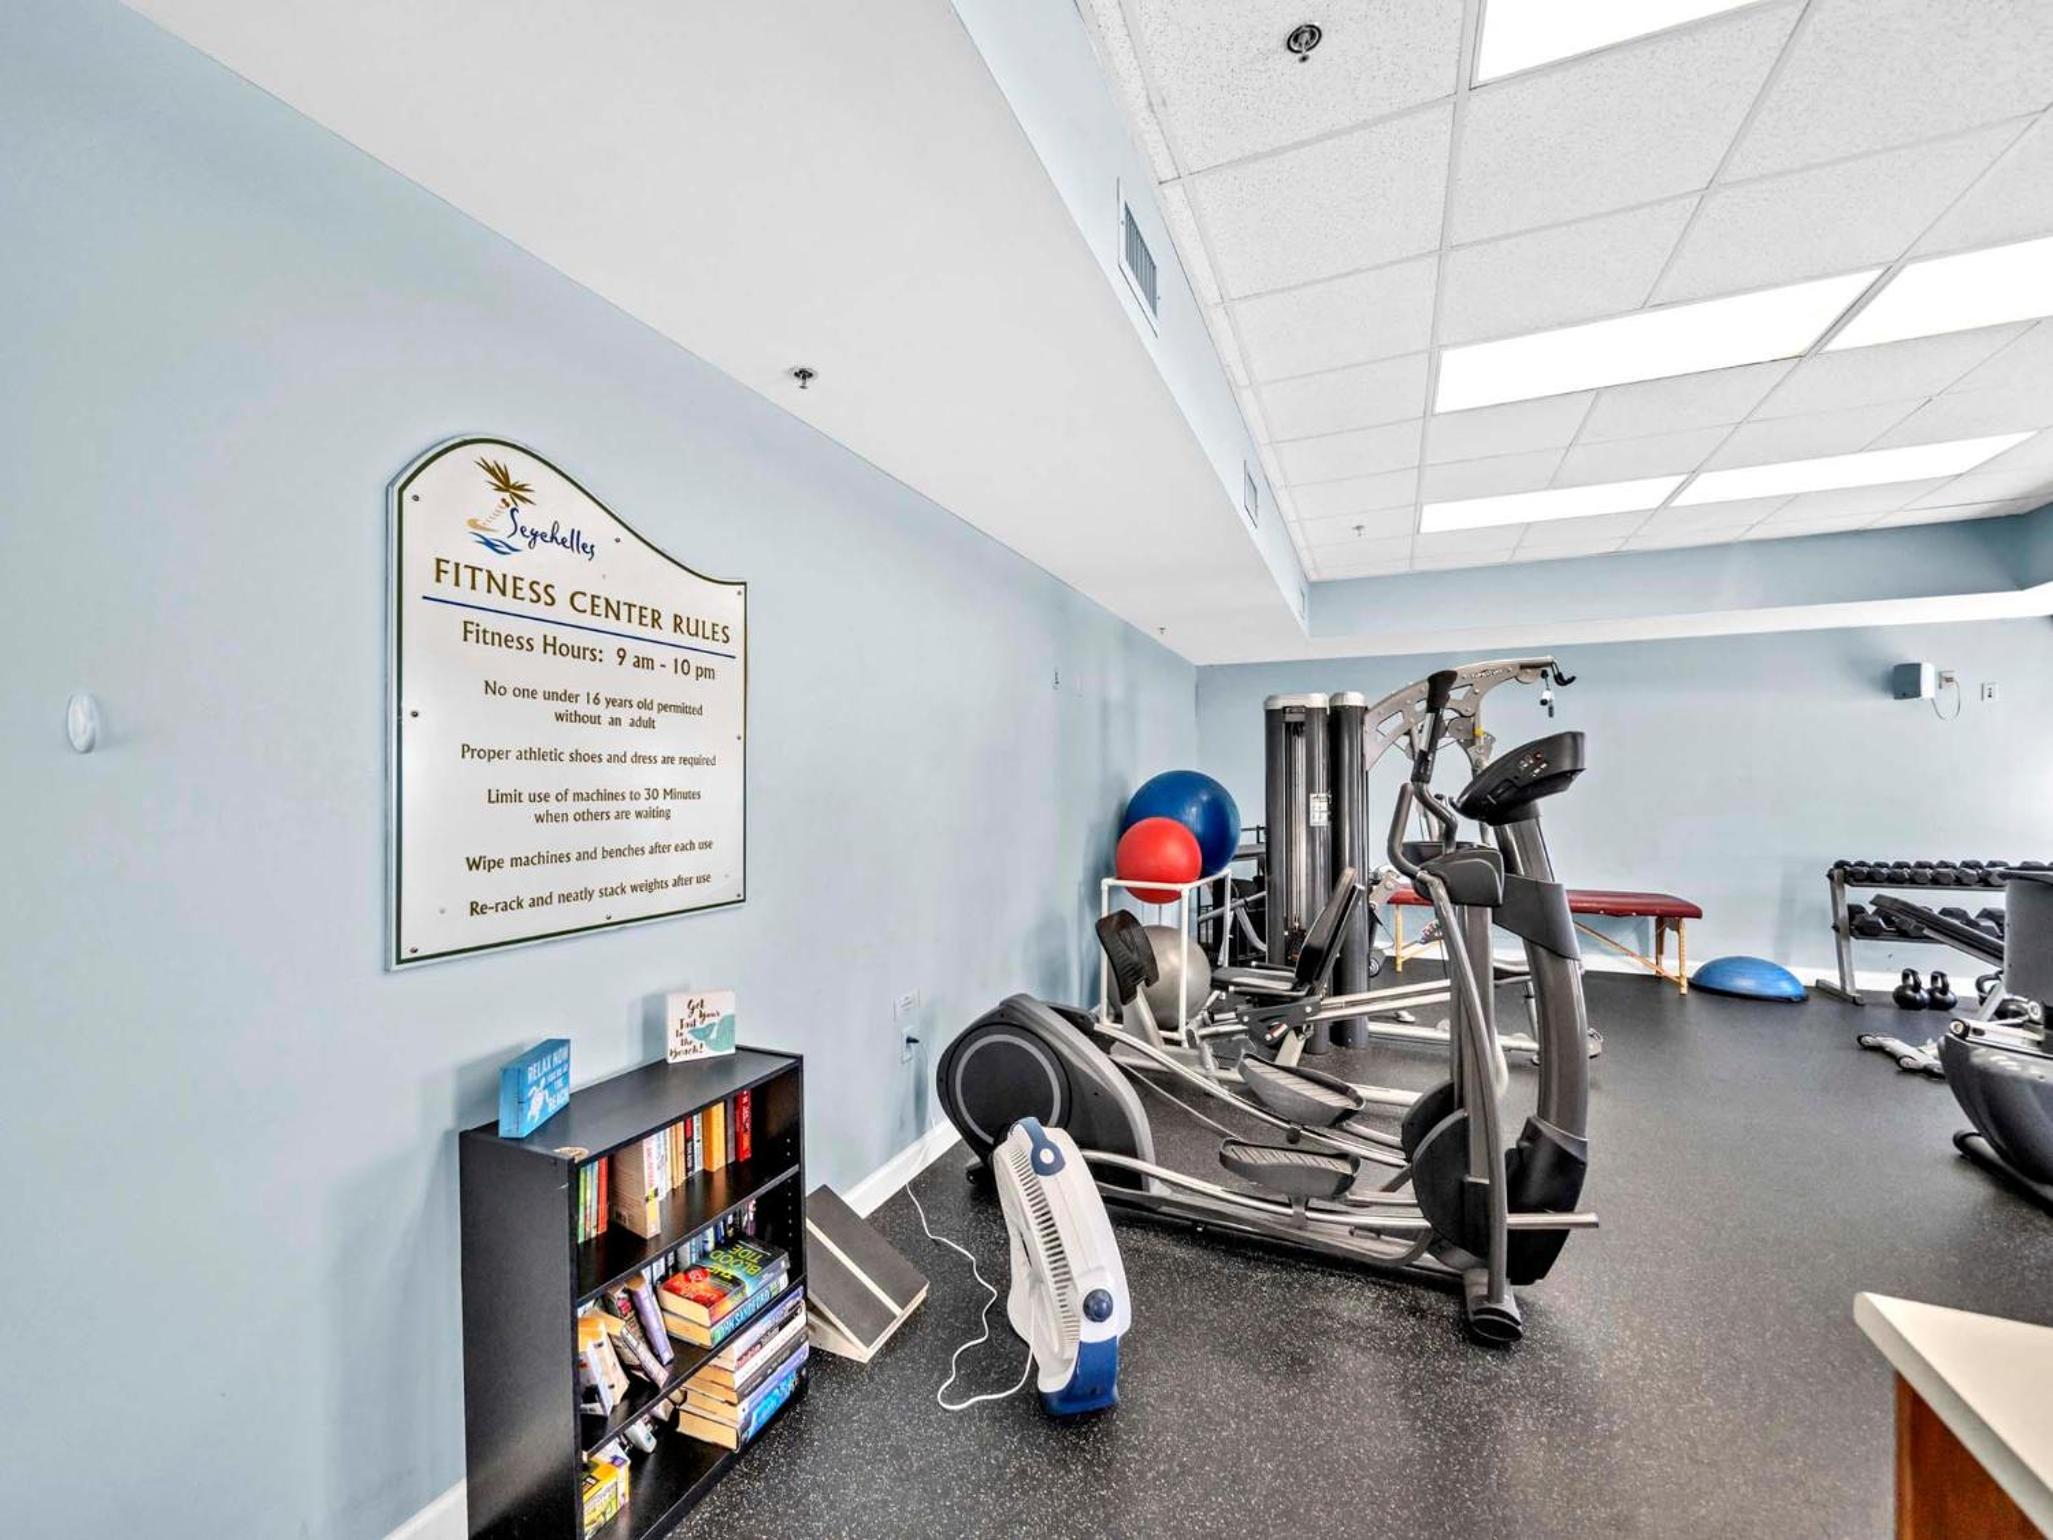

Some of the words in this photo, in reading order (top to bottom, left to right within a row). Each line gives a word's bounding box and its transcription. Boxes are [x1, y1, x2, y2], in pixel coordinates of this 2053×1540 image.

[507, 507, 595, 561] Seychelles
[434, 558, 556, 606] FITNESS
[569, 590, 663, 630] CENTER
[673, 613, 731, 644] RULES
[462, 620, 535, 653] Fitness
[543, 634, 603, 662] Hours:
[616, 647, 627, 666] 9
[632, 654, 655, 670] am
[673, 658, 691, 676] 10
[695, 664, 716, 681] pm
[484, 680, 507, 697] No
[512, 687, 538, 700] one
[543, 689, 581, 704] under
[586, 691, 601, 706] 16
[605, 696, 634, 709] years
[637, 698, 654, 711] old
[657, 702, 703, 716] permitted
[554, 709, 602, 725] without
[608, 716, 622, 727] an
[629, 716, 656, 729] adult
[461, 743, 512, 763] Proper
[515, 747, 565, 762] athletic
[568, 749, 603, 763] shoes
[606, 751, 627, 764] and
[631, 751, 658, 765] dress
[661, 755, 676, 765] are
[679, 754, 717, 768] required
[487, 788, 524, 804] Limit
[528, 791, 551, 803] use
[555, 788, 569, 802] of
[573, 788, 626, 802] machines
[629, 790, 641, 801] to
[644, 788, 660, 801] 30
[663, 788, 702, 801] Minutes
[534, 809, 569, 823] when
[573, 808, 611, 822] others
[614, 809, 631, 820] are
[634, 806, 672, 821] waiting
[465, 855, 505, 873] Wipe
[510, 850, 571, 868] machines
[575, 846, 598, 861] and
[602, 844, 646, 859] benches
[648, 841, 673, 855] after
[674, 839, 696, 852] each
[698, 840, 714, 850] use
[470, 895, 524, 917] Re-rack
[528, 891, 553, 908] and
[558, 887, 595, 903] neatly
[598, 882, 627, 898] stack
[630, 878, 669, 893] weights
[672, 874, 693, 888] after
[696, 873, 712, 884] use
[687, 998, 704, 1018] Get
[709, 1250, 762, 1276] BLOOD
